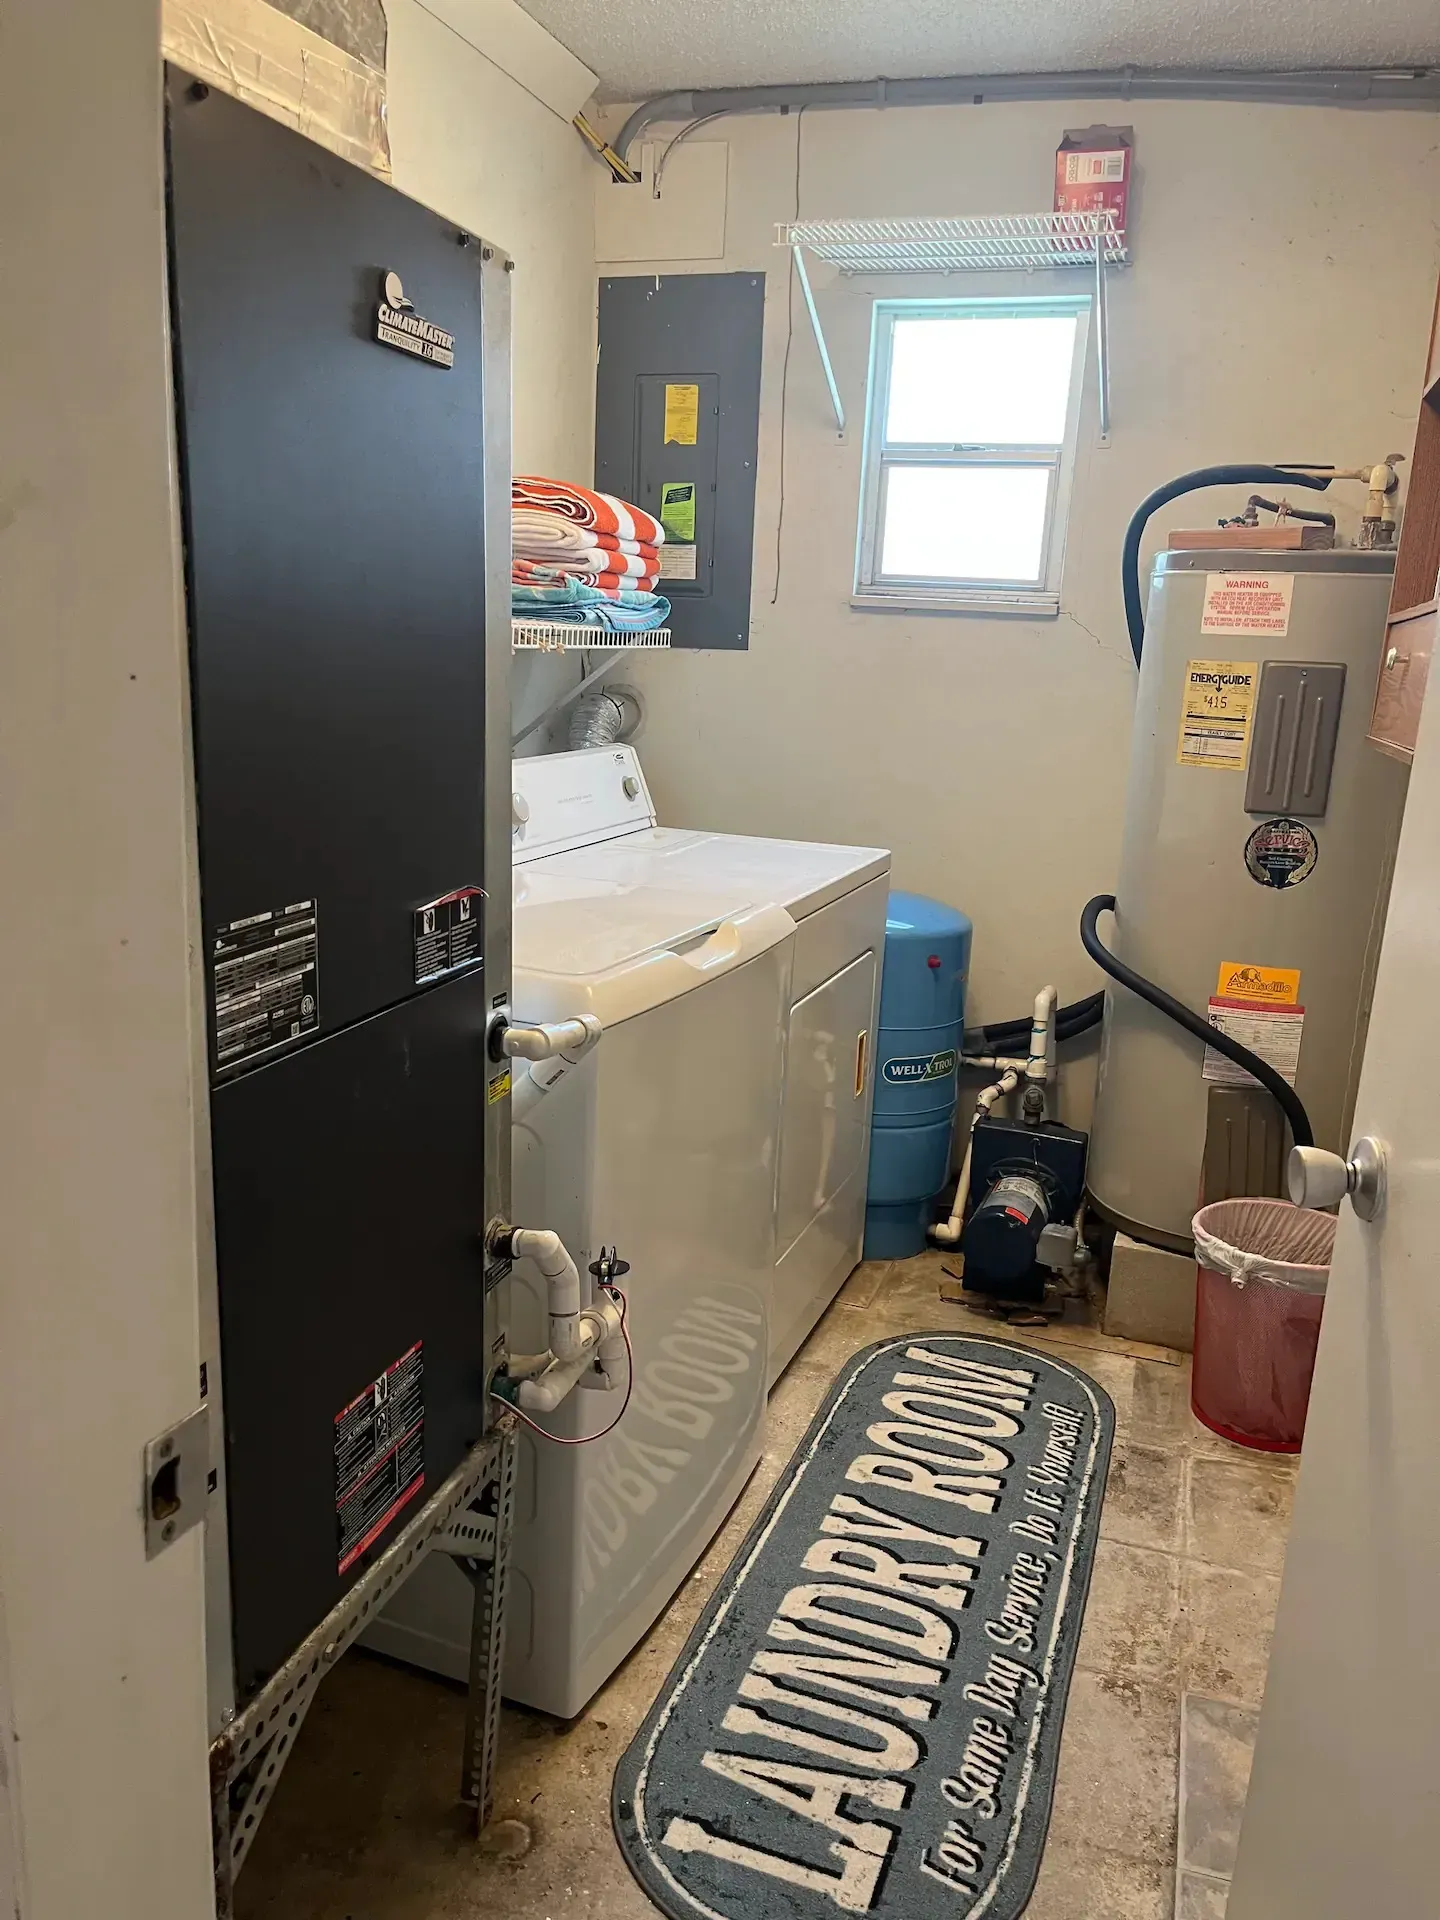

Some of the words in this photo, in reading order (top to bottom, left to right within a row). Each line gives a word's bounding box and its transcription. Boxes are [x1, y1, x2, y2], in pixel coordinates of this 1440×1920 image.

[423, 343, 433, 357] 16
[1226, 580, 1269, 589] WARNING
[1190, 672, 1252, 687] ENERGYGUIDE
[1204, 695, 1228, 709] $415
[1226, 972, 1292, 993] Armadillo
[1026, 1402, 1087, 1487] Yourself!
[1023, 1486, 1066, 1514] It
[1008, 1513, 1060, 1546] Do
[985, 1550, 1062, 1654] Service,
[661, 1494, 986, 1913] LAUNDRY
[844, 1346, 1037, 1514] ROOM
[963, 1653, 1043, 1717] Day
[941, 1715, 1013, 1820] Same
[920, 1819, 984, 1895] For
